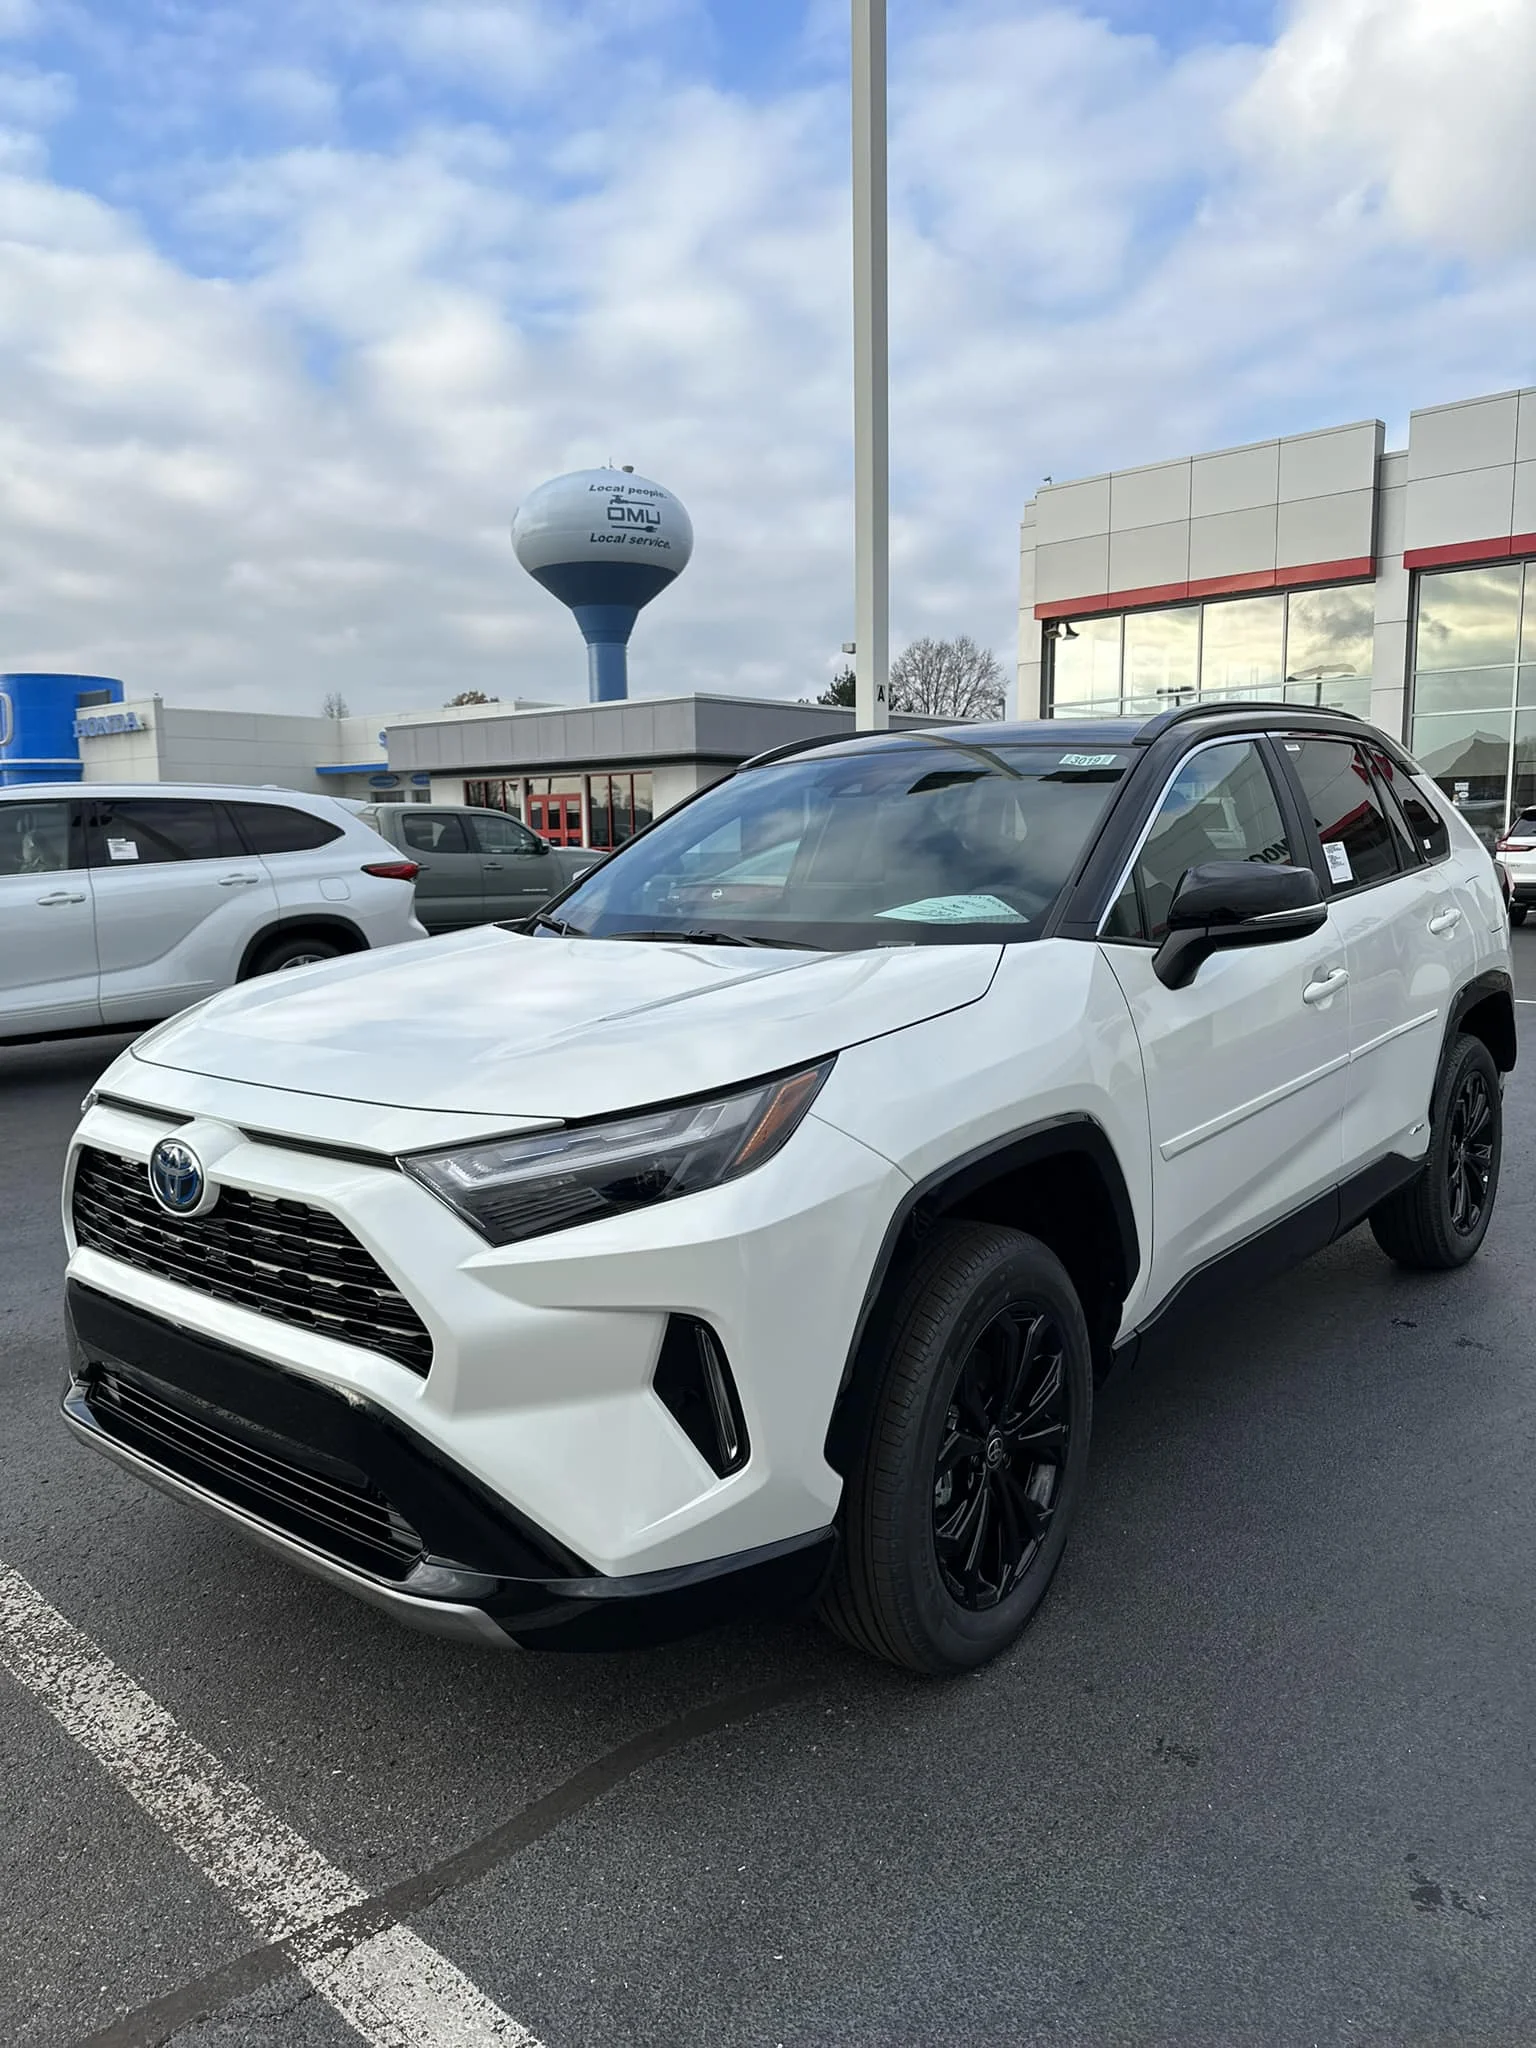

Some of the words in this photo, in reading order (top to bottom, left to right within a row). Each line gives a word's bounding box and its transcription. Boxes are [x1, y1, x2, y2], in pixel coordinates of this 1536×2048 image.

[589, 484, 625, 493] Local
[627, 487, 668, 499] people.
[607, 506, 661, 525] OMU
[589, 533, 627, 543] Local
[628, 535, 671, 549] service.
[876, 684, 886, 702] A
[73, 711, 142, 738] HONDA
